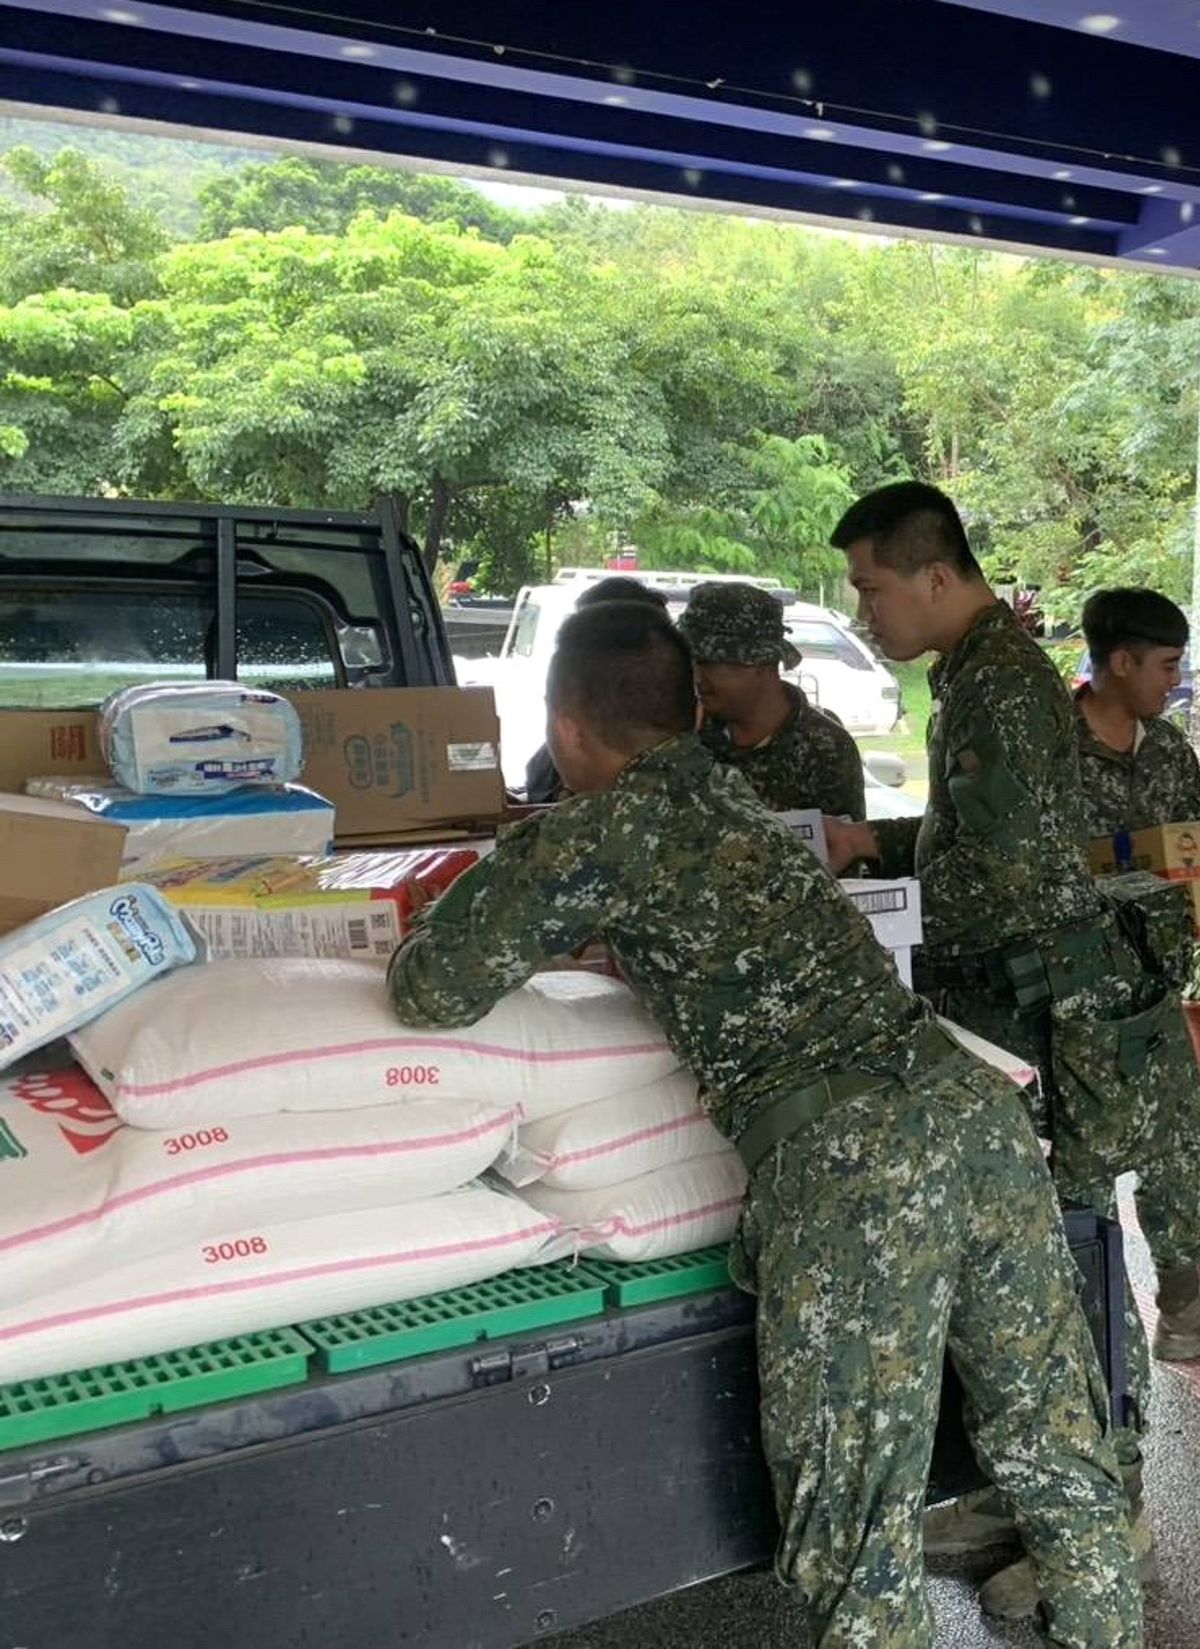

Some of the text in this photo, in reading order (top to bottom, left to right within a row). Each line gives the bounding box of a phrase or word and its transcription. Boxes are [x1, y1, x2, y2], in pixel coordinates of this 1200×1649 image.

[385, 1066, 440, 1086] 3008
[163, 1126, 230, 1156] 3008
[202, 1236, 268, 1264] 3008
